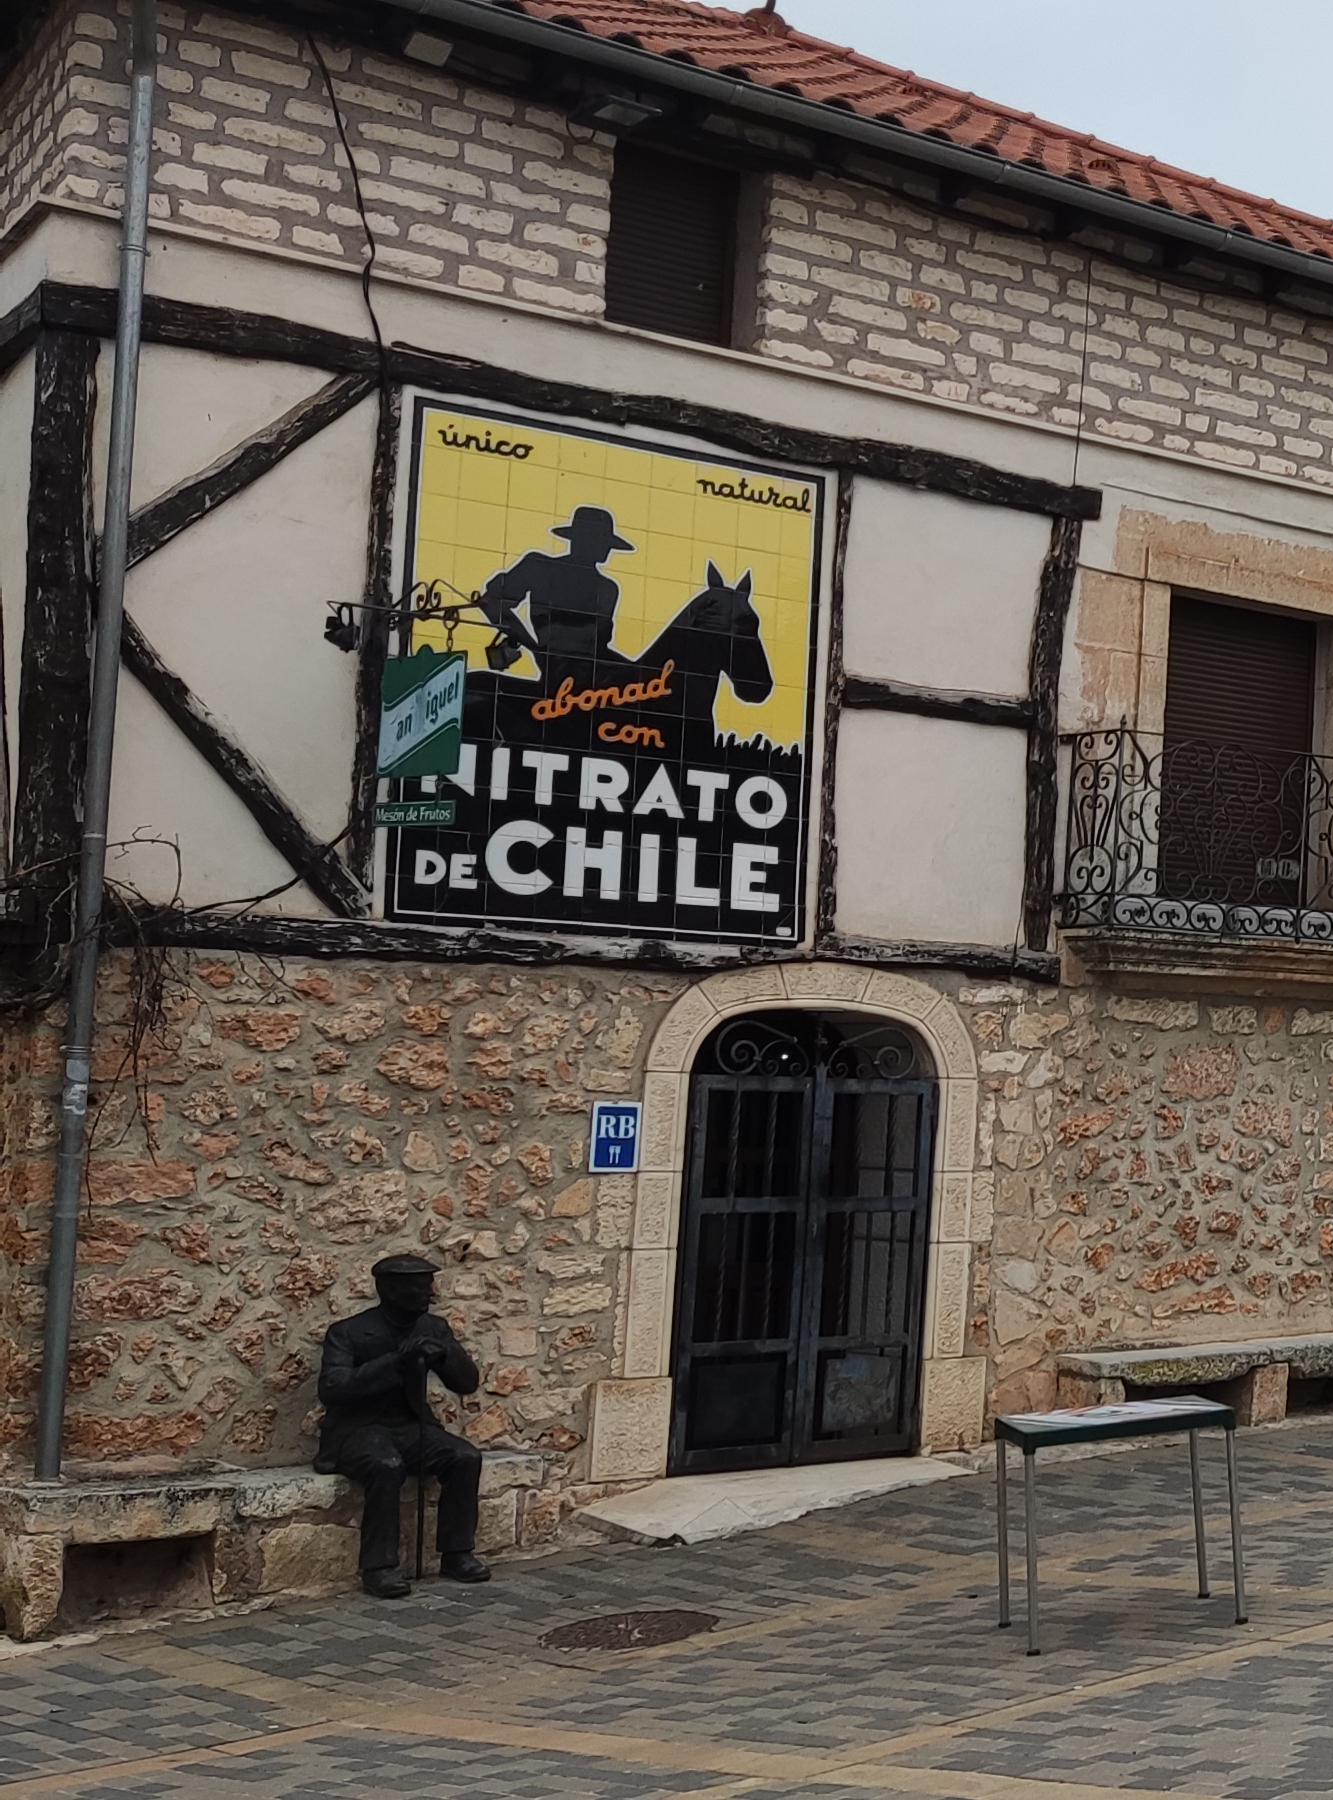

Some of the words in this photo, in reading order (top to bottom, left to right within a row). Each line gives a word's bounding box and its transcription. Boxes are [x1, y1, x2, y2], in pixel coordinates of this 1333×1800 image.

[437, 424, 534, 460] único
[696, 478, 811, 513] natural
[416, 670, 460, 731] iguel
[531, 659, 675, 720] abonad
[598, 722, 665, 748] con
[375, 808, 404, 822] Mesón
[406, 806, 417, 821] de
[420, 806, 450, 821] Frutos
[415, 850, 478, 890] DE
[485, 820, 780, 912] CHILE
[598, 1114, 635, 1139] RB
